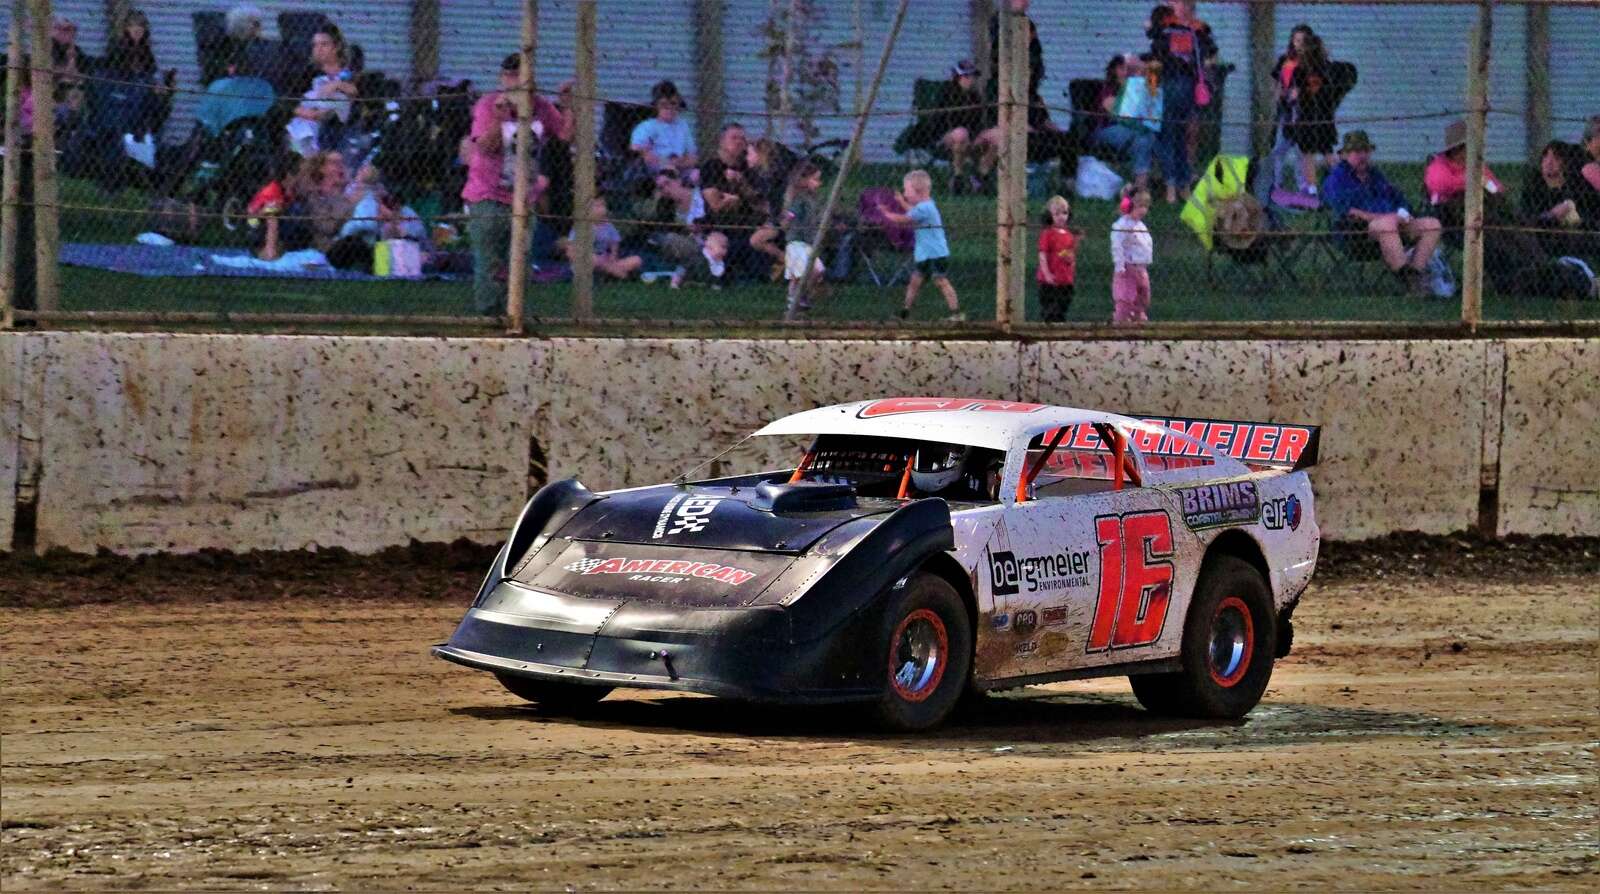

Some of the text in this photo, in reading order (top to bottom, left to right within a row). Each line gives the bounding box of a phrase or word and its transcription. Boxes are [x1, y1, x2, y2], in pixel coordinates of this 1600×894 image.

[1181, 481, 1257, 514] BRIMS
[1261, 498, 1287, 530] elf
[583, 557, 756, 586] AMERICAN
[629, 574, 685, 584] RACER
[992, 546, 1090, 593] bergmeier
[1039, 576, 1090, 592] ENVIRONMENTAL
[1085, 508, 1175, 654] 16
